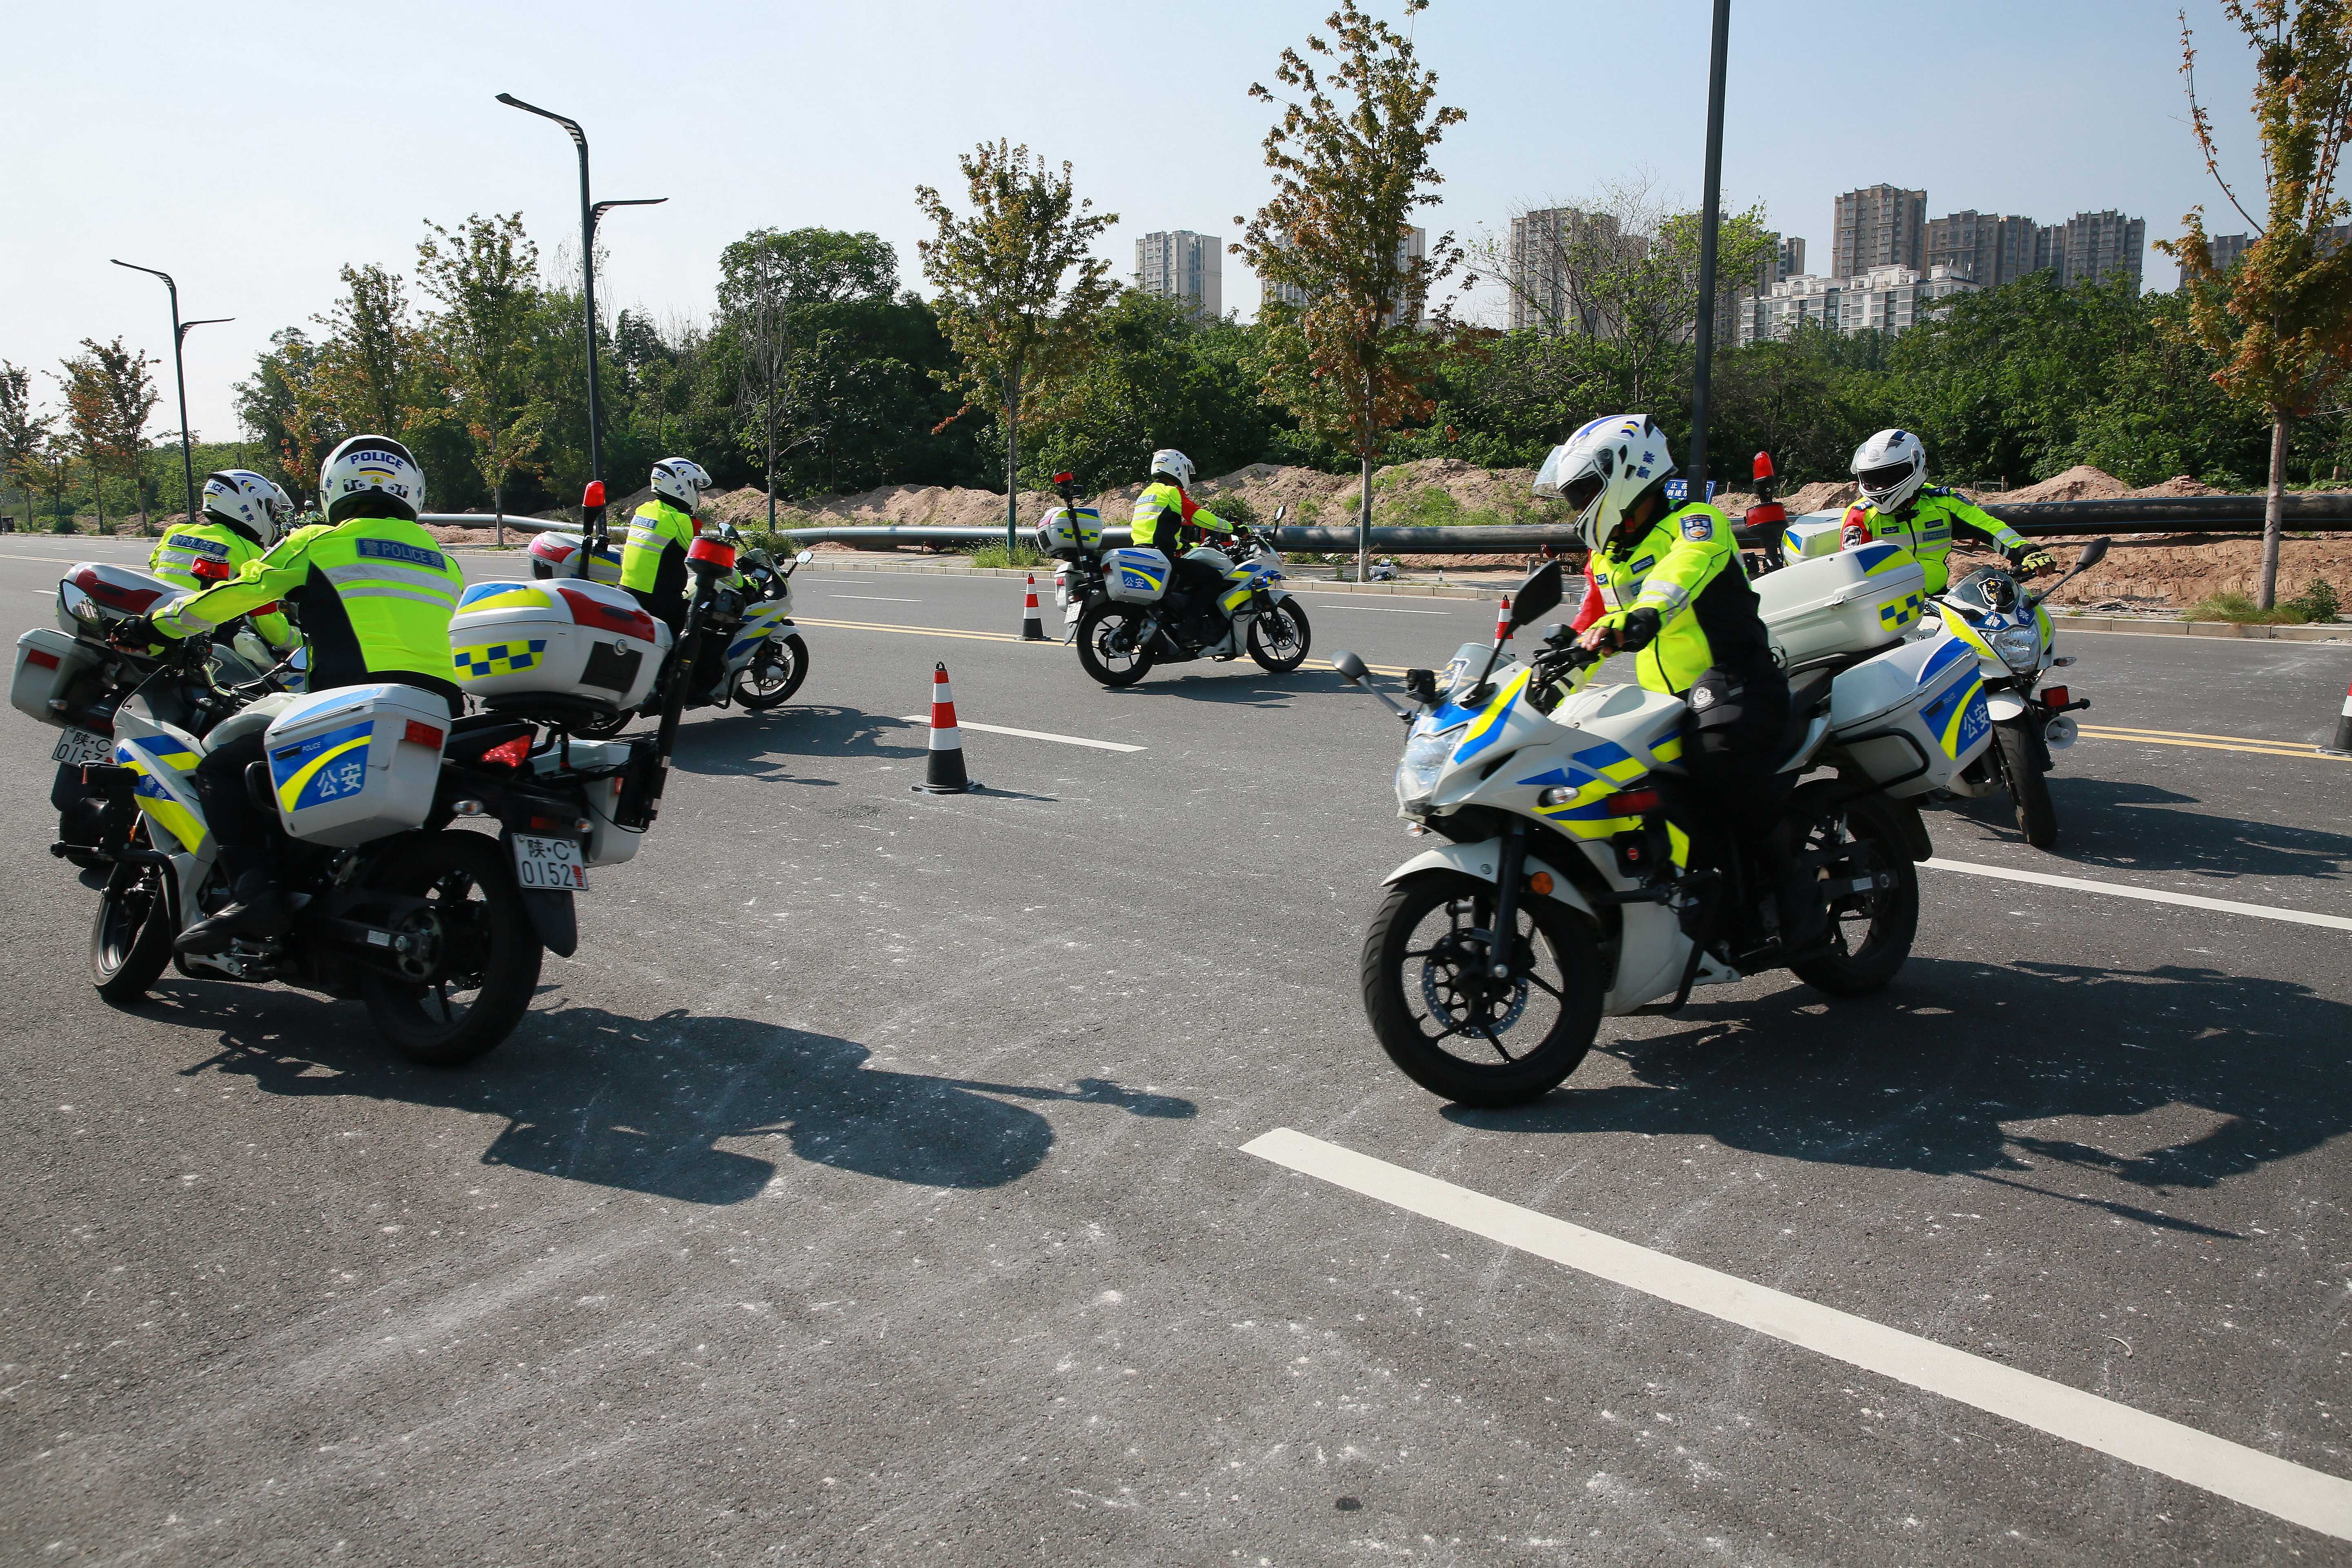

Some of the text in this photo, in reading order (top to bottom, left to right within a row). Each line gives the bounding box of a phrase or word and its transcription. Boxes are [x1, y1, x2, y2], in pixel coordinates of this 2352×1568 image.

[350, 452, 403, 470] POLICE
[382, 543, 428, 563] POLICE
[1124, 577, 1145, 588] 公安
[1963, 703, 1989, 739] 公安
[302, 742, 321, 752] POLICE
[316, 762, 363, 798] 公安
